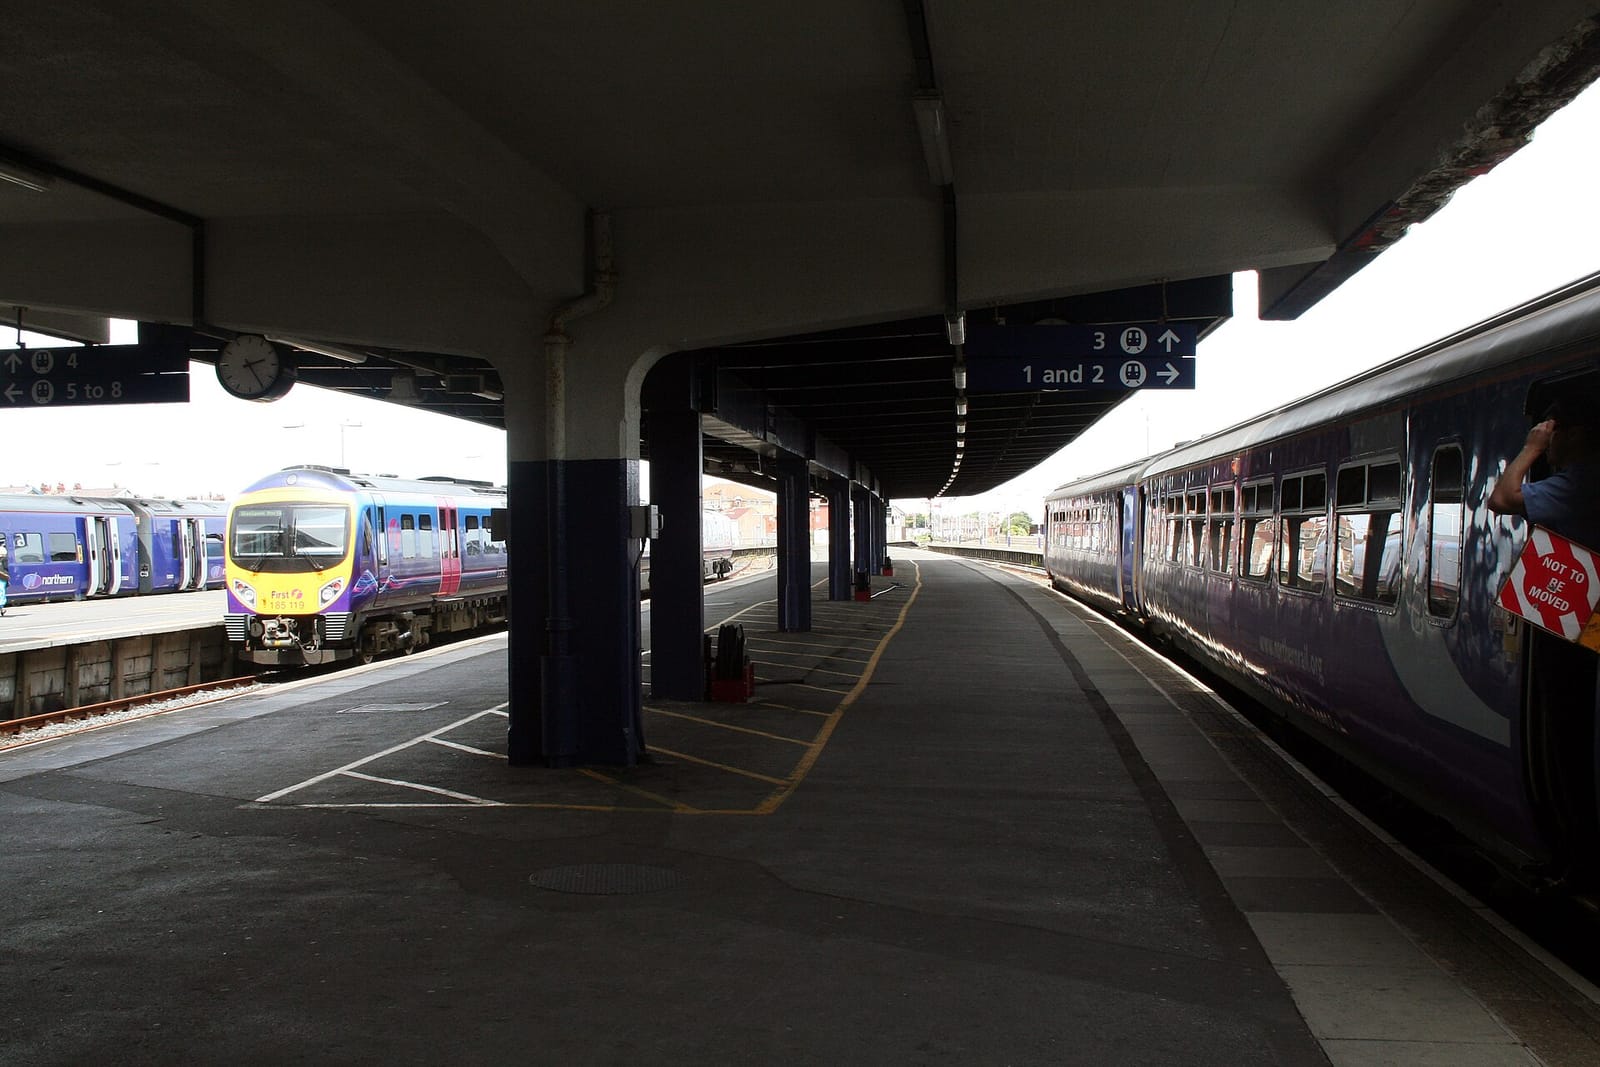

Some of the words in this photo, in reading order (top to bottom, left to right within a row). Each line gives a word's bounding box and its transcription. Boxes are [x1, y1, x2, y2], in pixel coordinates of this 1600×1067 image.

[1093, 332, 1105, 350] 3
[67, 353, 78, 369] 4
[1022, 365, 1032, 383] 1
[1043, 364, 1083, 383] and
[1092, 365, 1105, 383] 2
[66, 384, 77, 400] 5
[84, 383, 104, 399] to
[111, 381, 123, 398] 8
[1542, 556, 1568, 575] NOT
[1570, 569, 1585, 584] TO
[42, 574, 74, 585] northern
[1549, 577, 1566, 592] BE
[271, 590, 289, 599] First
[1528, 585, 1570, 612] MOVED
[270, 601, 286, 610] 185
